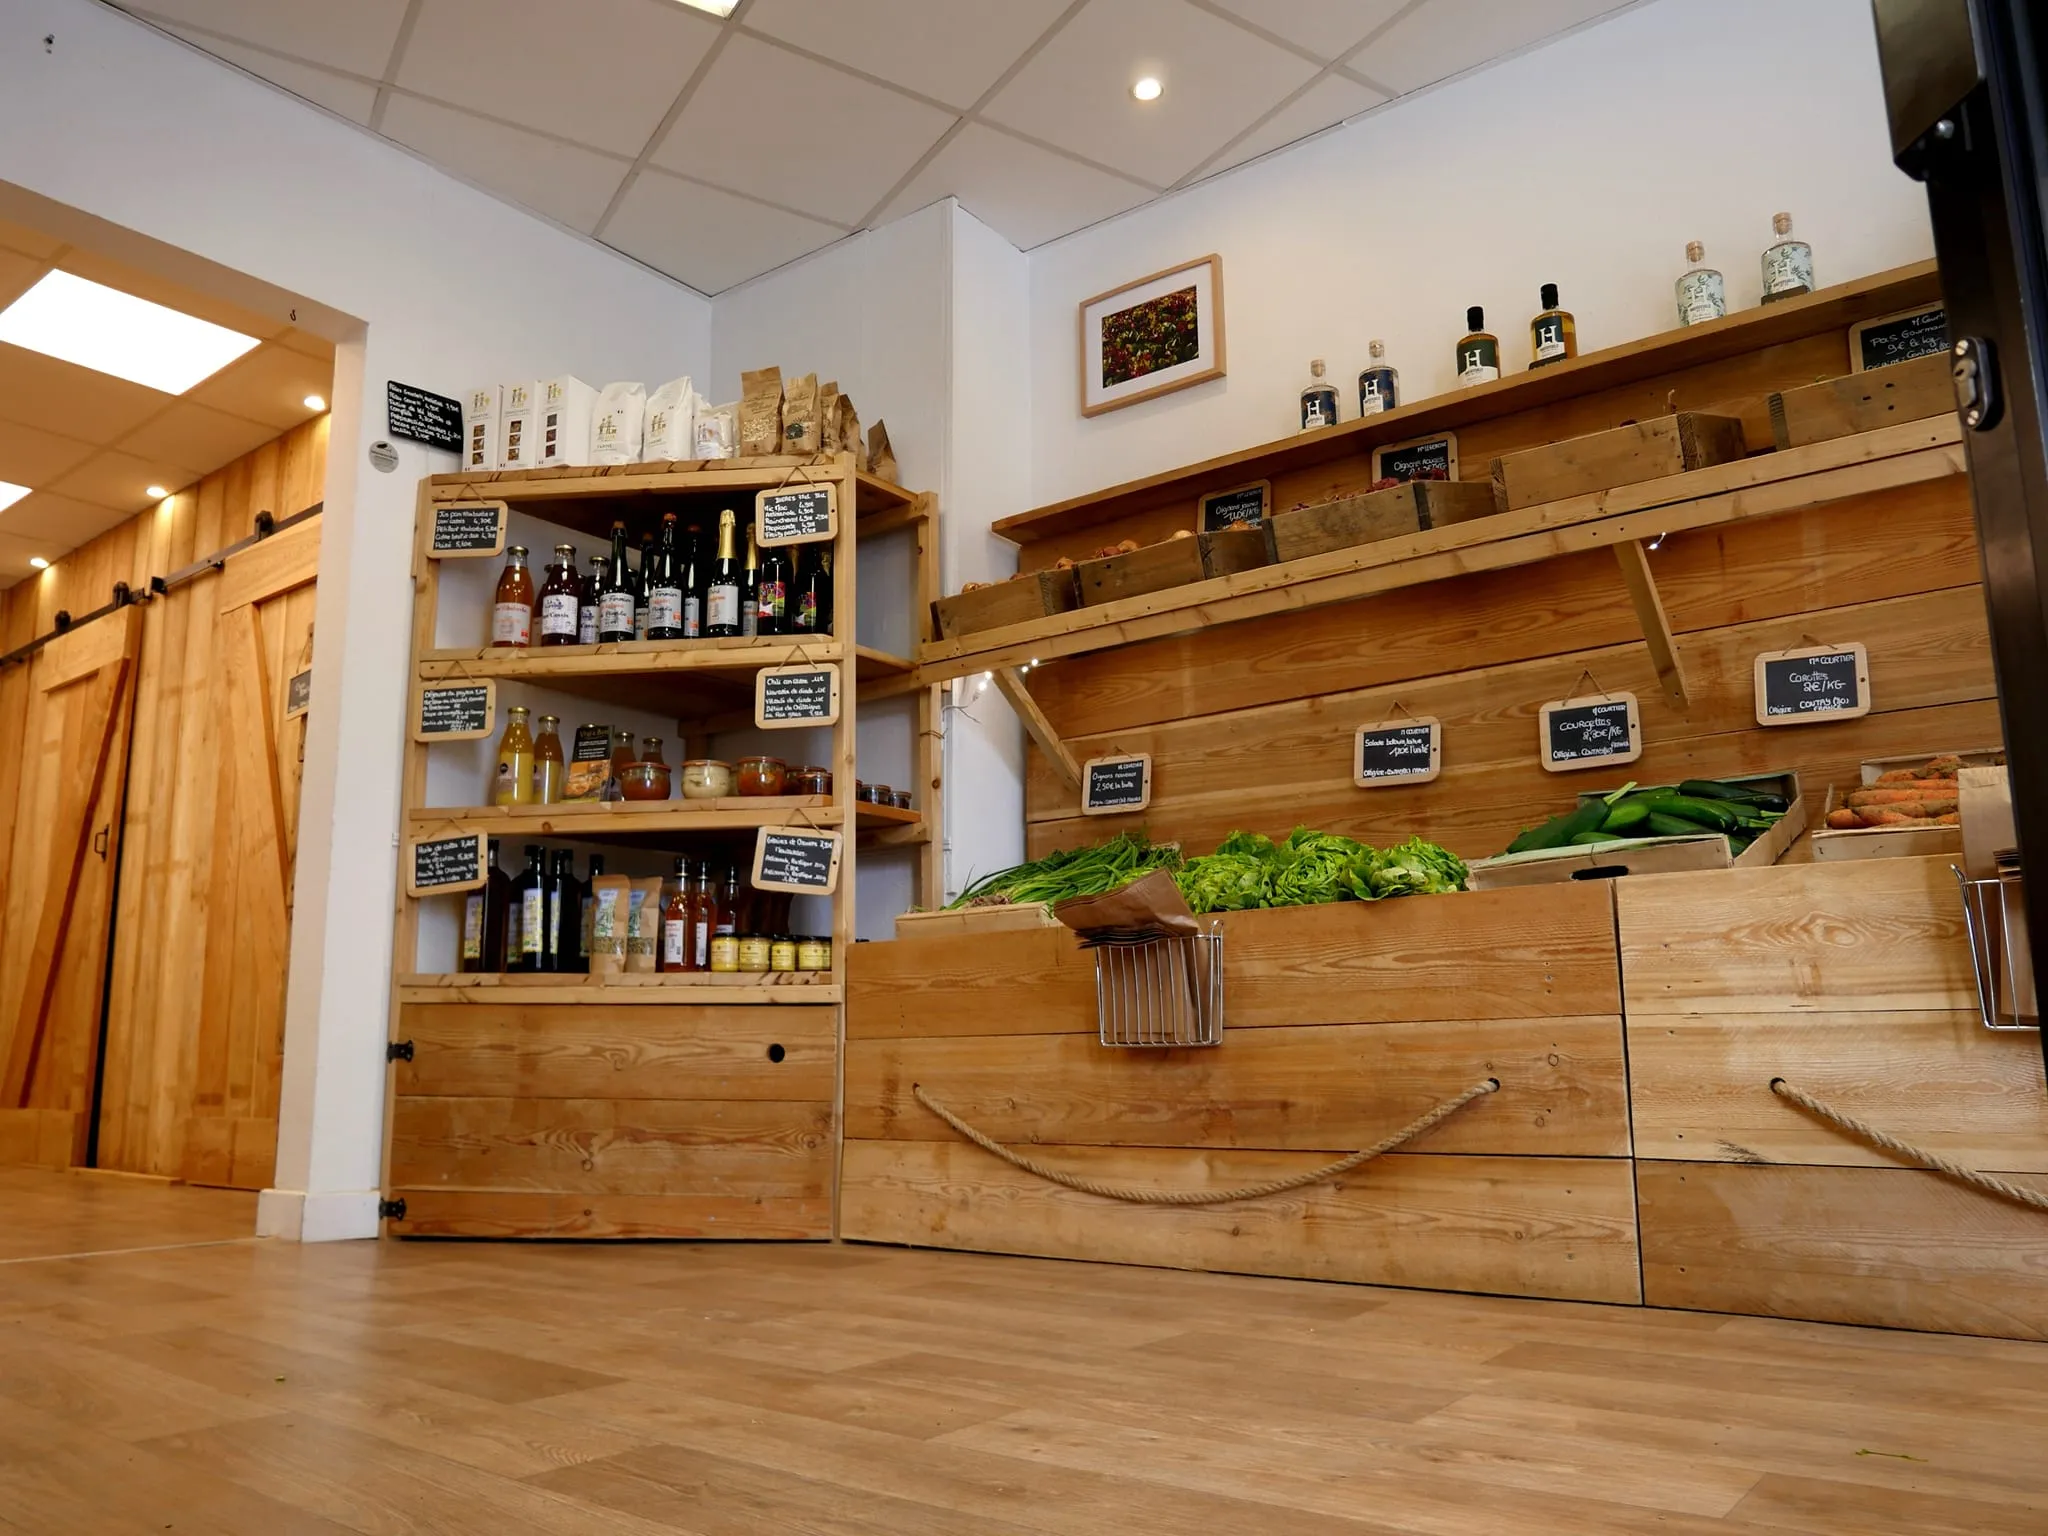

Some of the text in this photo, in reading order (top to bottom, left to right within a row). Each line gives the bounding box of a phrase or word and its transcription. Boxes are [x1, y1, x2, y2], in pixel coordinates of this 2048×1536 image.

[1539, 325, 1557, 345] H
[1464, 349, 1482, 369] H
[1364, 379, 1379, 397] H
[1306, 399, 1321, 417] H
